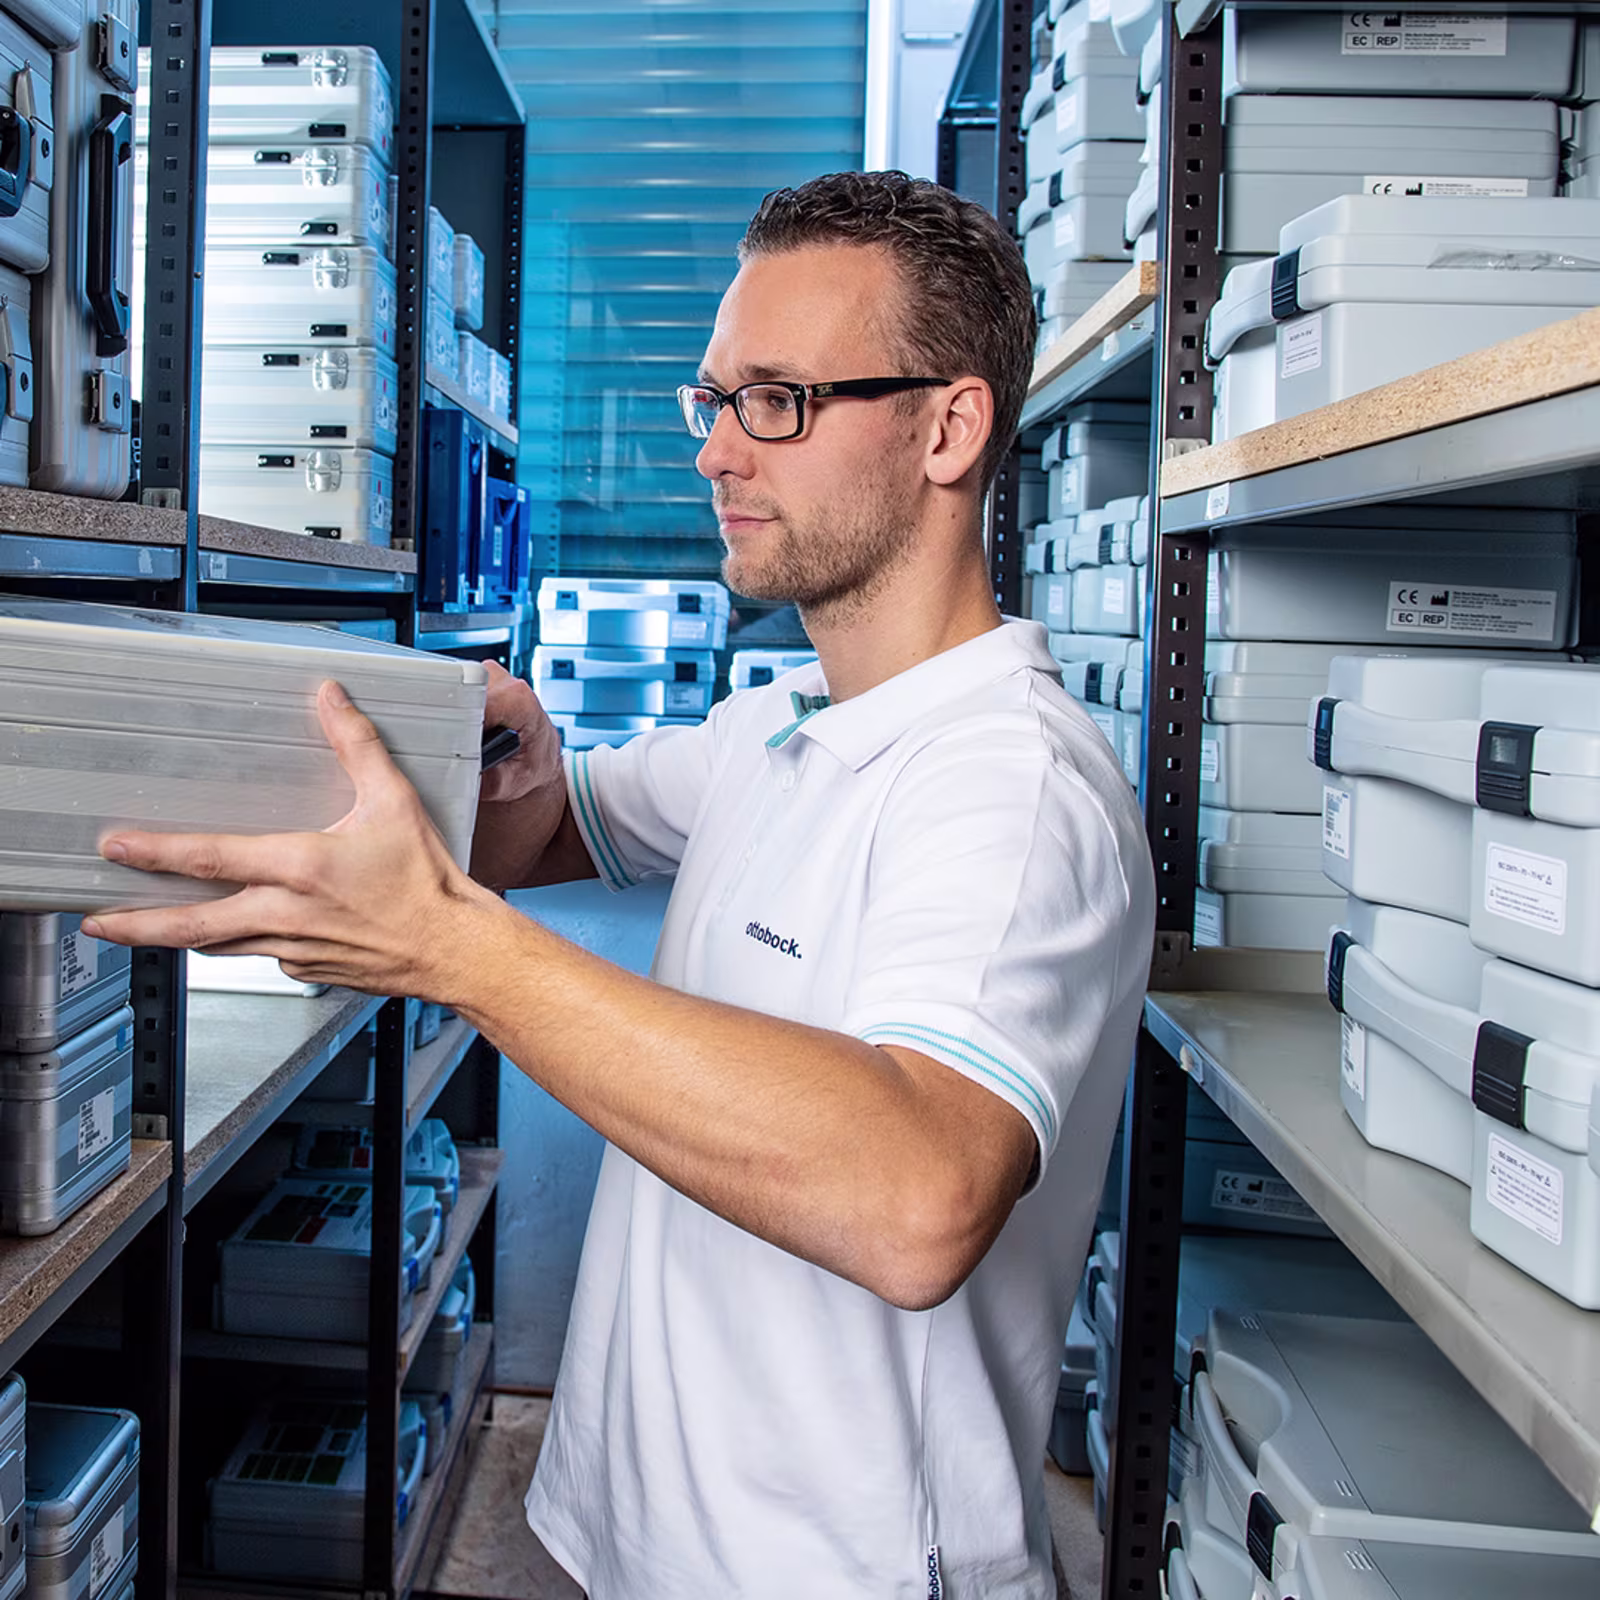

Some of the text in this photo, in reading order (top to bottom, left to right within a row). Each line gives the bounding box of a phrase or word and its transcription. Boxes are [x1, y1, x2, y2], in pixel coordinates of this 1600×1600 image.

[1351, 12, 1371, 27] CE
[1352, 36, 1368, 46] EC
[1376, 36, 1398, 46] REP
[1397, 589, 1419, 605] CE
[1398, 612, 1413, 623] EC
[1423, 614, 1445, 625] REP
